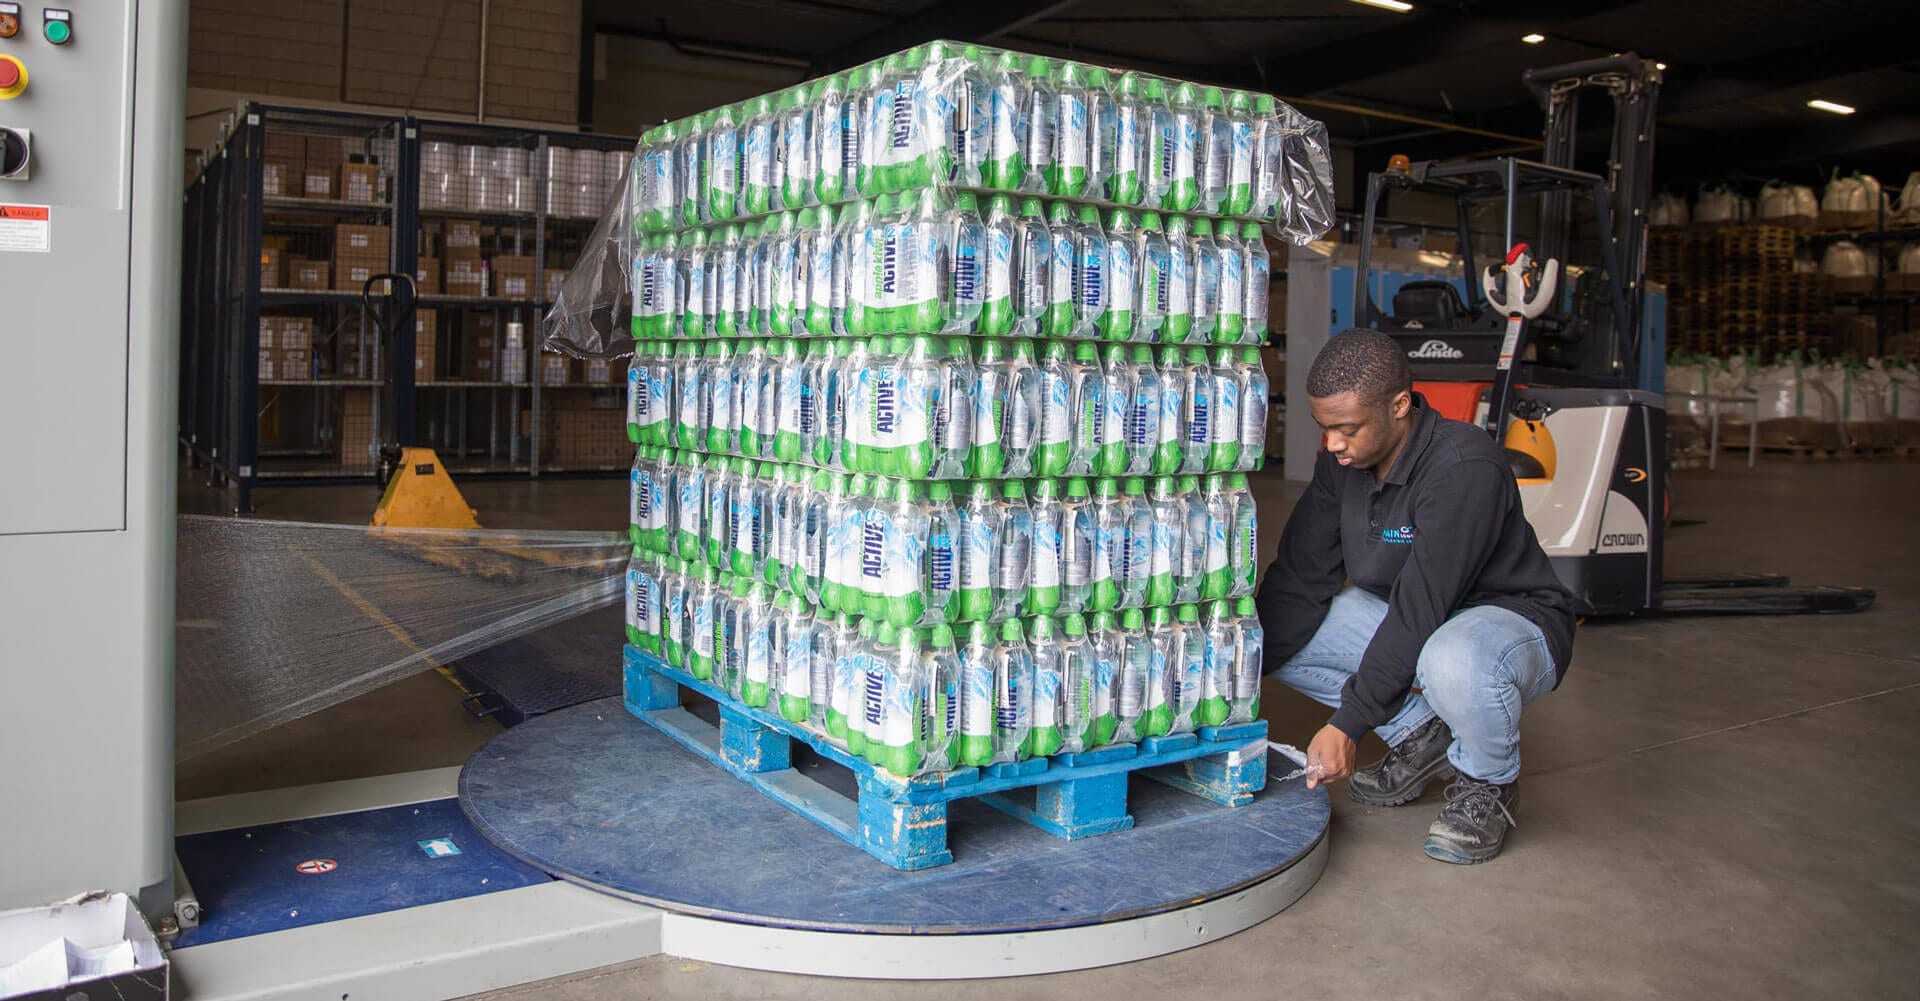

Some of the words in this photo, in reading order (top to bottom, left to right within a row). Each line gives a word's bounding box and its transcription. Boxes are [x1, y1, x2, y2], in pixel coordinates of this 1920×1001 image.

[894, 97, 912, 148] ACTIVE
[873, 238, 883, 264] kiwi
[883, 238, 896, 293] ACTIVE
[643, 263, 655, 307] ACTIVE
[873, 266, 883, 299] apple
[954, 255, 975, 300] ACTIVE
[1082, 265, 1100, 307] ACTIVE
[1407, 340, 1464, 359] Linde
[638, 377, 647, 415] ACTIVE
[877, 381, 894, 434] ACTIVE
[1190, 404, 1208, 443] ACTIVE
[639, 483, 648, 519] ACTIVE
[862, 521, 885, 579] ACTIVE
[930, 546, 952, 591] ACTIVE
[637, 582, 649, 621] ACTIVE
[866, 671, 885, 726] ACTIVE
